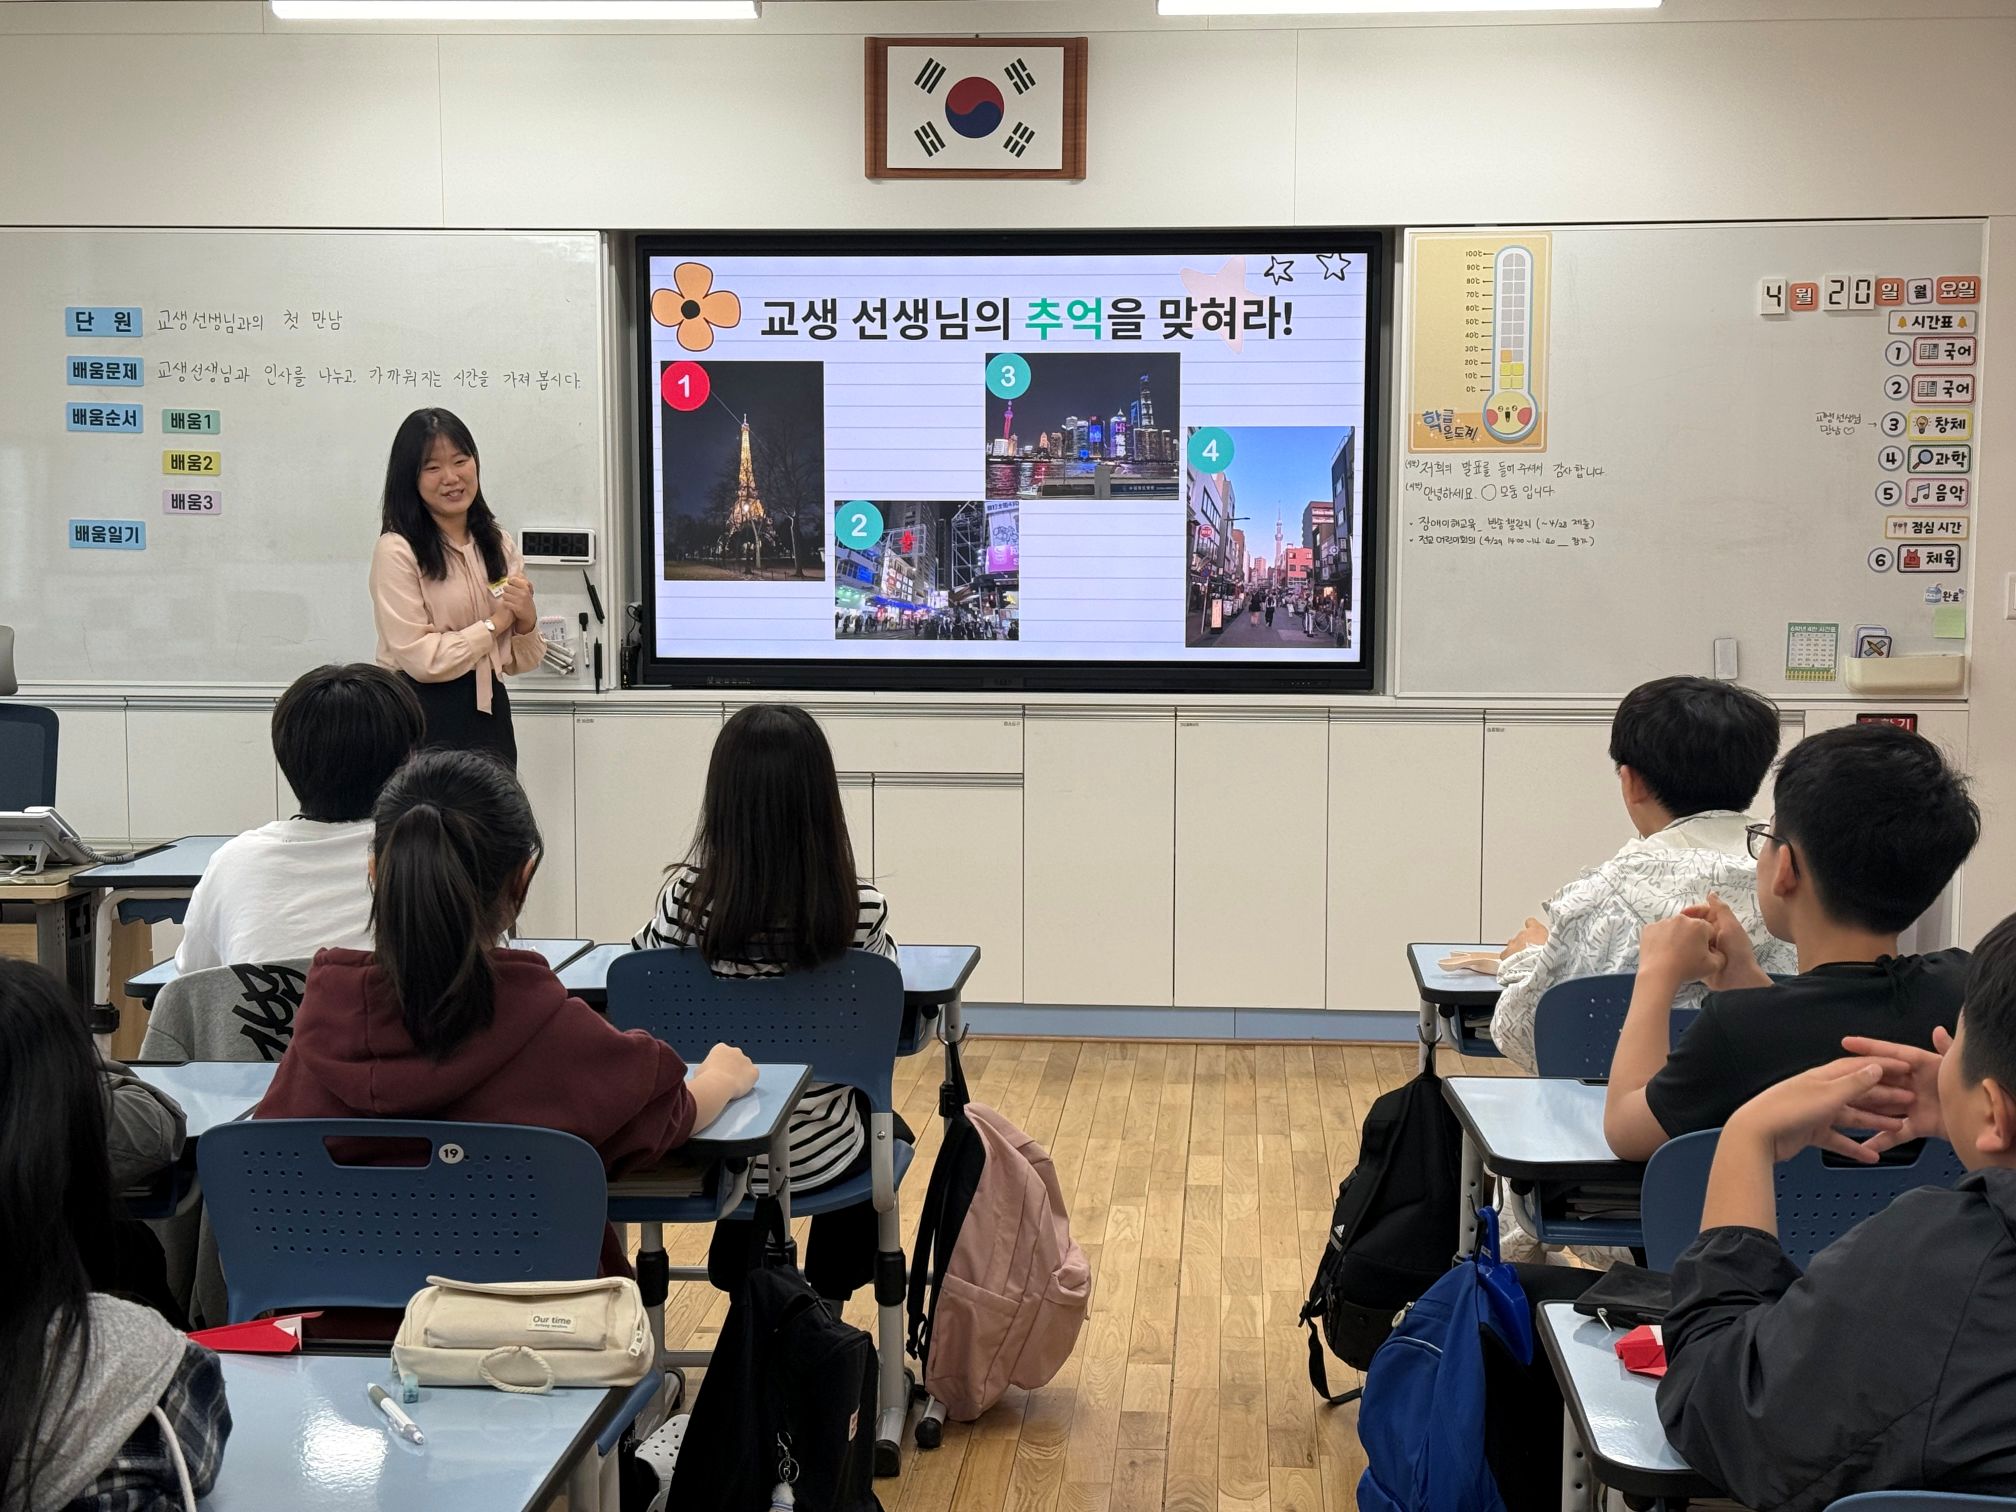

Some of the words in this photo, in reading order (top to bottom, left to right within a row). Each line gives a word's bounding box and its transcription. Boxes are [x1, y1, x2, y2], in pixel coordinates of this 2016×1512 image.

[283, 309, 300, 330] 첫
[311, 310, 343, 331] 만남
[761, 297, 838, 341] 교생
[852, 296, 1010, 341] 선생님의
[1025, 296, 1146, 341] 추억을
[1159, 296, 1293, 340] 맞혀라!
[1911, 315, 1953, 330] 시간표
[1894, 347, 1902, 361] 1
[1944, 343, 1972, 360] 국어
[72, 361, 138, 381] 배움문제
[264, 363, 306, 388] 인사를
[453, 368, 489, 388] 시간을
[1000, 365, 1016, 387] 3
[677, 374, 691, 398] 1
[1891, 381, 1902, 395] 2
[1942, 381, 1970, 398] 국어
[72, 408, 137, 428] 배움순서
[170, 412, 211, 430] 배움1
[1422, 408, 1454, 433] 학급
[1888, 418, 1900, 431] 3
[1935, 416, 1966, 433] 창체
[1443, 425, 1479, 442] 온도계
[1202, 439, 1220, 462] 4
[1886, 452, 1897, 465] 4
[1935, 450, 1967, 468] 과학
[170, 453, 213, 472] 배움2
[1420, 461, 1452, 478] 저희의
[1461, 459, 1490, 477] 발표를
[171, 493, 213, 511] 배움3
[1883, 487, 1894, 500] 5
[1935, 484, 1965, 502] 음악
[75, 524, 140, 544] 배움일기
[850, 513, 868, 538] 2
[1911, 521, 1935, 534] 점심
[1937, 521, 1962, 534] 시간
[1875, 553, 1886, 567] 6
[1925, 549, 1956, 568] 체육
[1942, 591, 1961, 602] 완료
[443, 1148, 459, 1158] 19
[532, 1315, 550, 1323] Our
[551, 1316, 572, 1325] time
